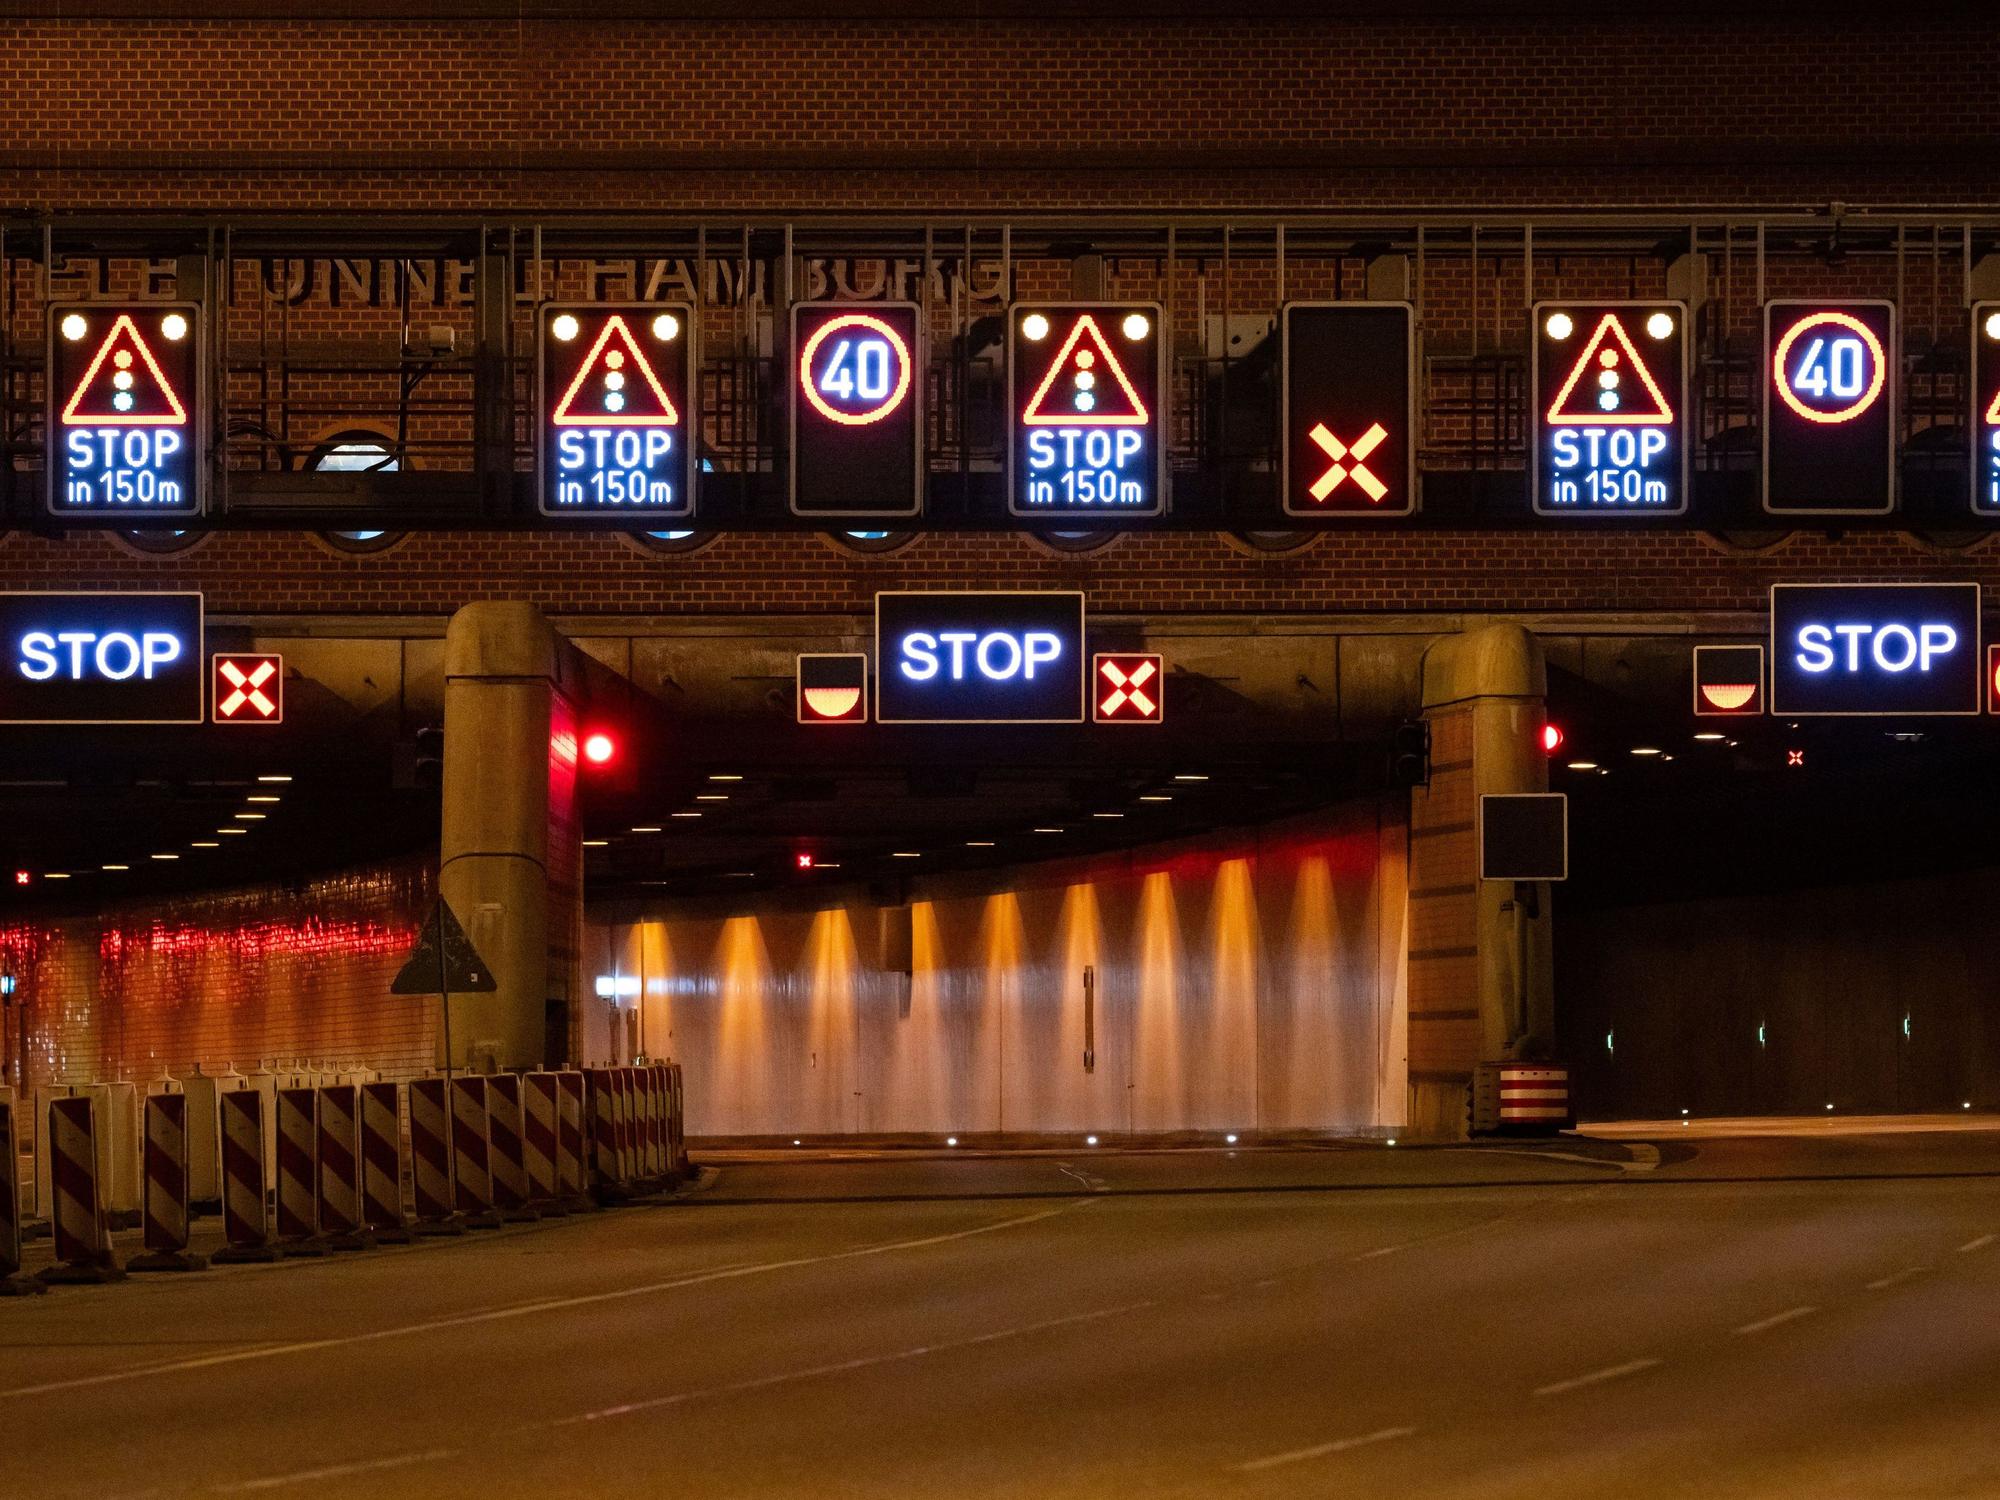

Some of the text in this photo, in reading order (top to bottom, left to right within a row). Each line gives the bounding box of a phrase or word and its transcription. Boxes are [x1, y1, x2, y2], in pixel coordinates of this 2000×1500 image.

[820, 340, 891, 399] 40
[1794, 338, 1864, 398] 40
[68, 429, 180, 468] STOP
[559, 429, 672, 468] STOP
[1029, 429, 1142, 468] STOP
[1553, 429, 1667, 468] STOP
[68, 469, 180, 503] in 150m
[559, 469, 672, 503] in 150m
[1029, 469, 1142, 503] in 150m
[1553, 469, 1667, 503] in 150m
[20, 632, 181, 680] STOP
[901, 632, 1062, 680] STOP
[1797, 624, 1958, 672] STOP
